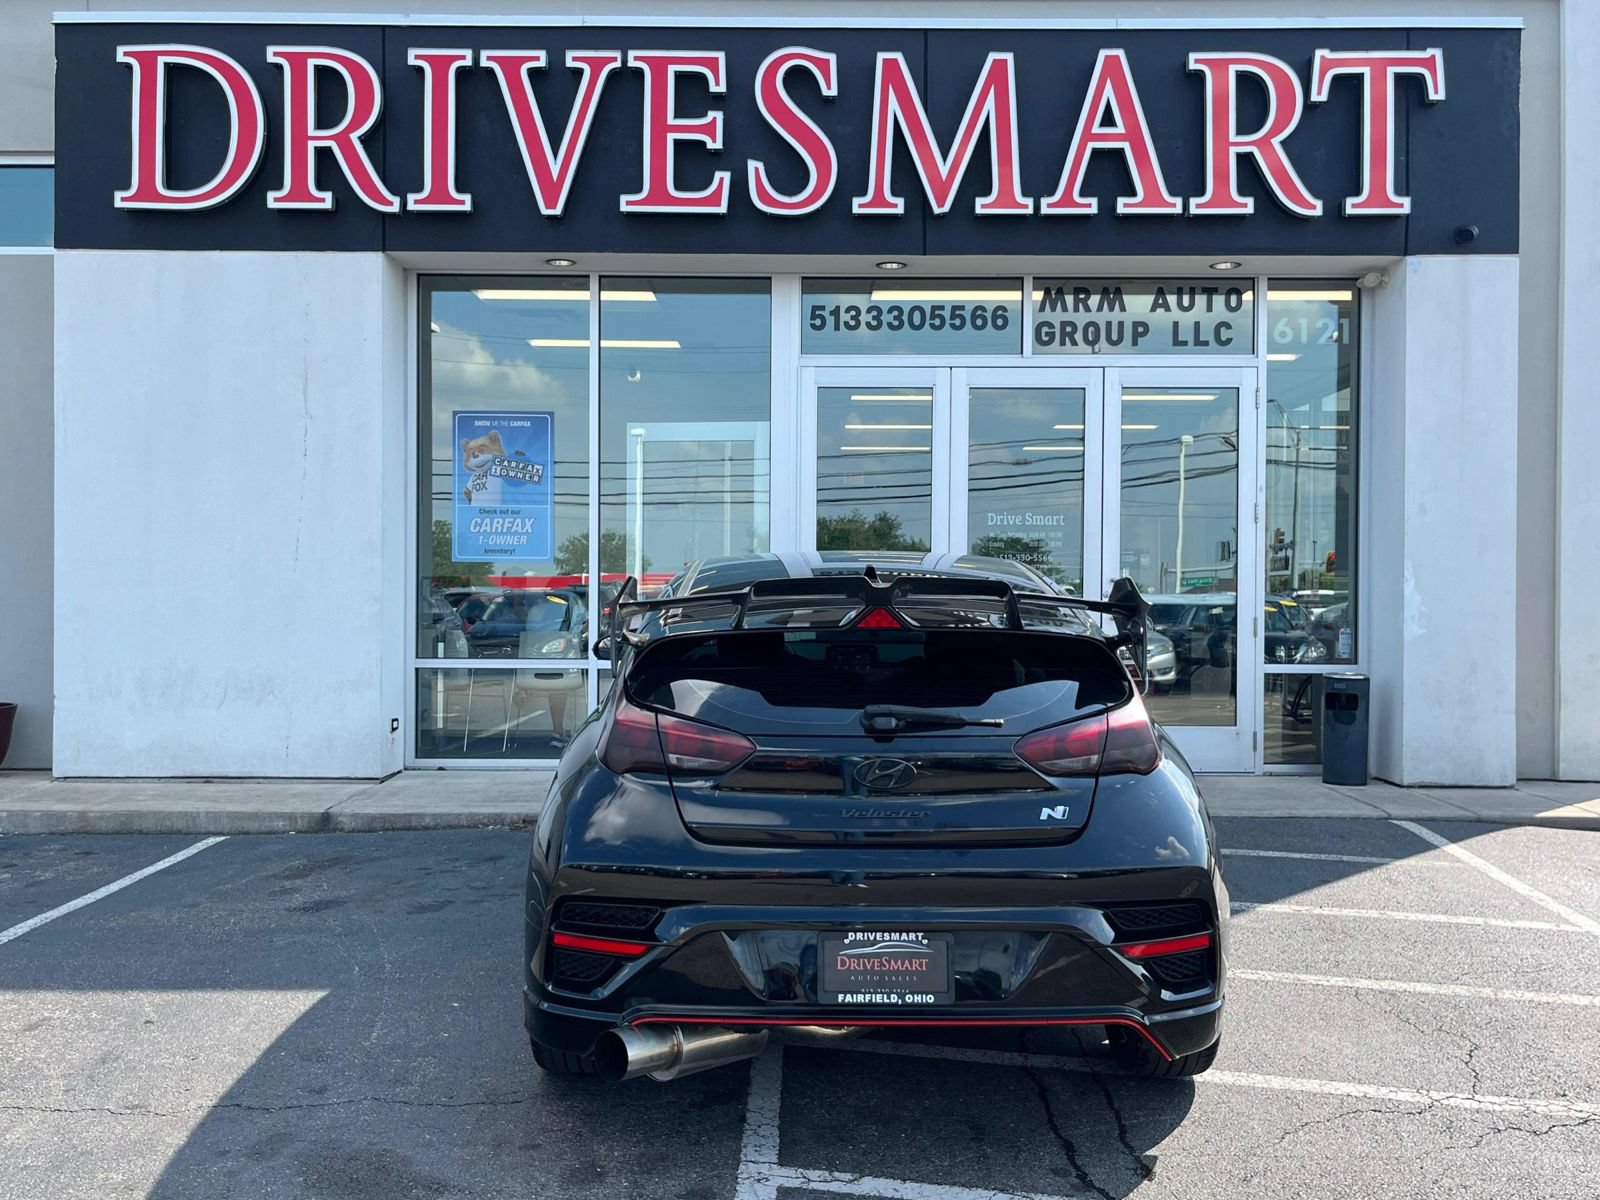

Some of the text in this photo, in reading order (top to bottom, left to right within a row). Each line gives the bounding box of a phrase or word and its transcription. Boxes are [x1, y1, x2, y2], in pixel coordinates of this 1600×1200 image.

[114, 44, 1446, 217] DRIVESMART
[1037, 286, 1244, 313] MRM AUTO
[808, 304, 1010, 332] 5133305566
[1033, 320, 1234, 347] GROUP LLC
[1272, 316, 1351, 345] 6121
[493, 457, 543, 474] CARFAX
[501, 468, 541, 483] OWNER
[470, 518, 535, 533] CARFAX
[987, 512, 1065, 526] Drive Smart
[478, 535, 528, 545] 1-OWNER
[484, 547, 516, 556] Inventory!
[839, 808, 931, 818] Veloster
[848, 932, 924, 941] DRIVESMART
[838, 994, 935, 1005] FAIRFIELD, OHIO
